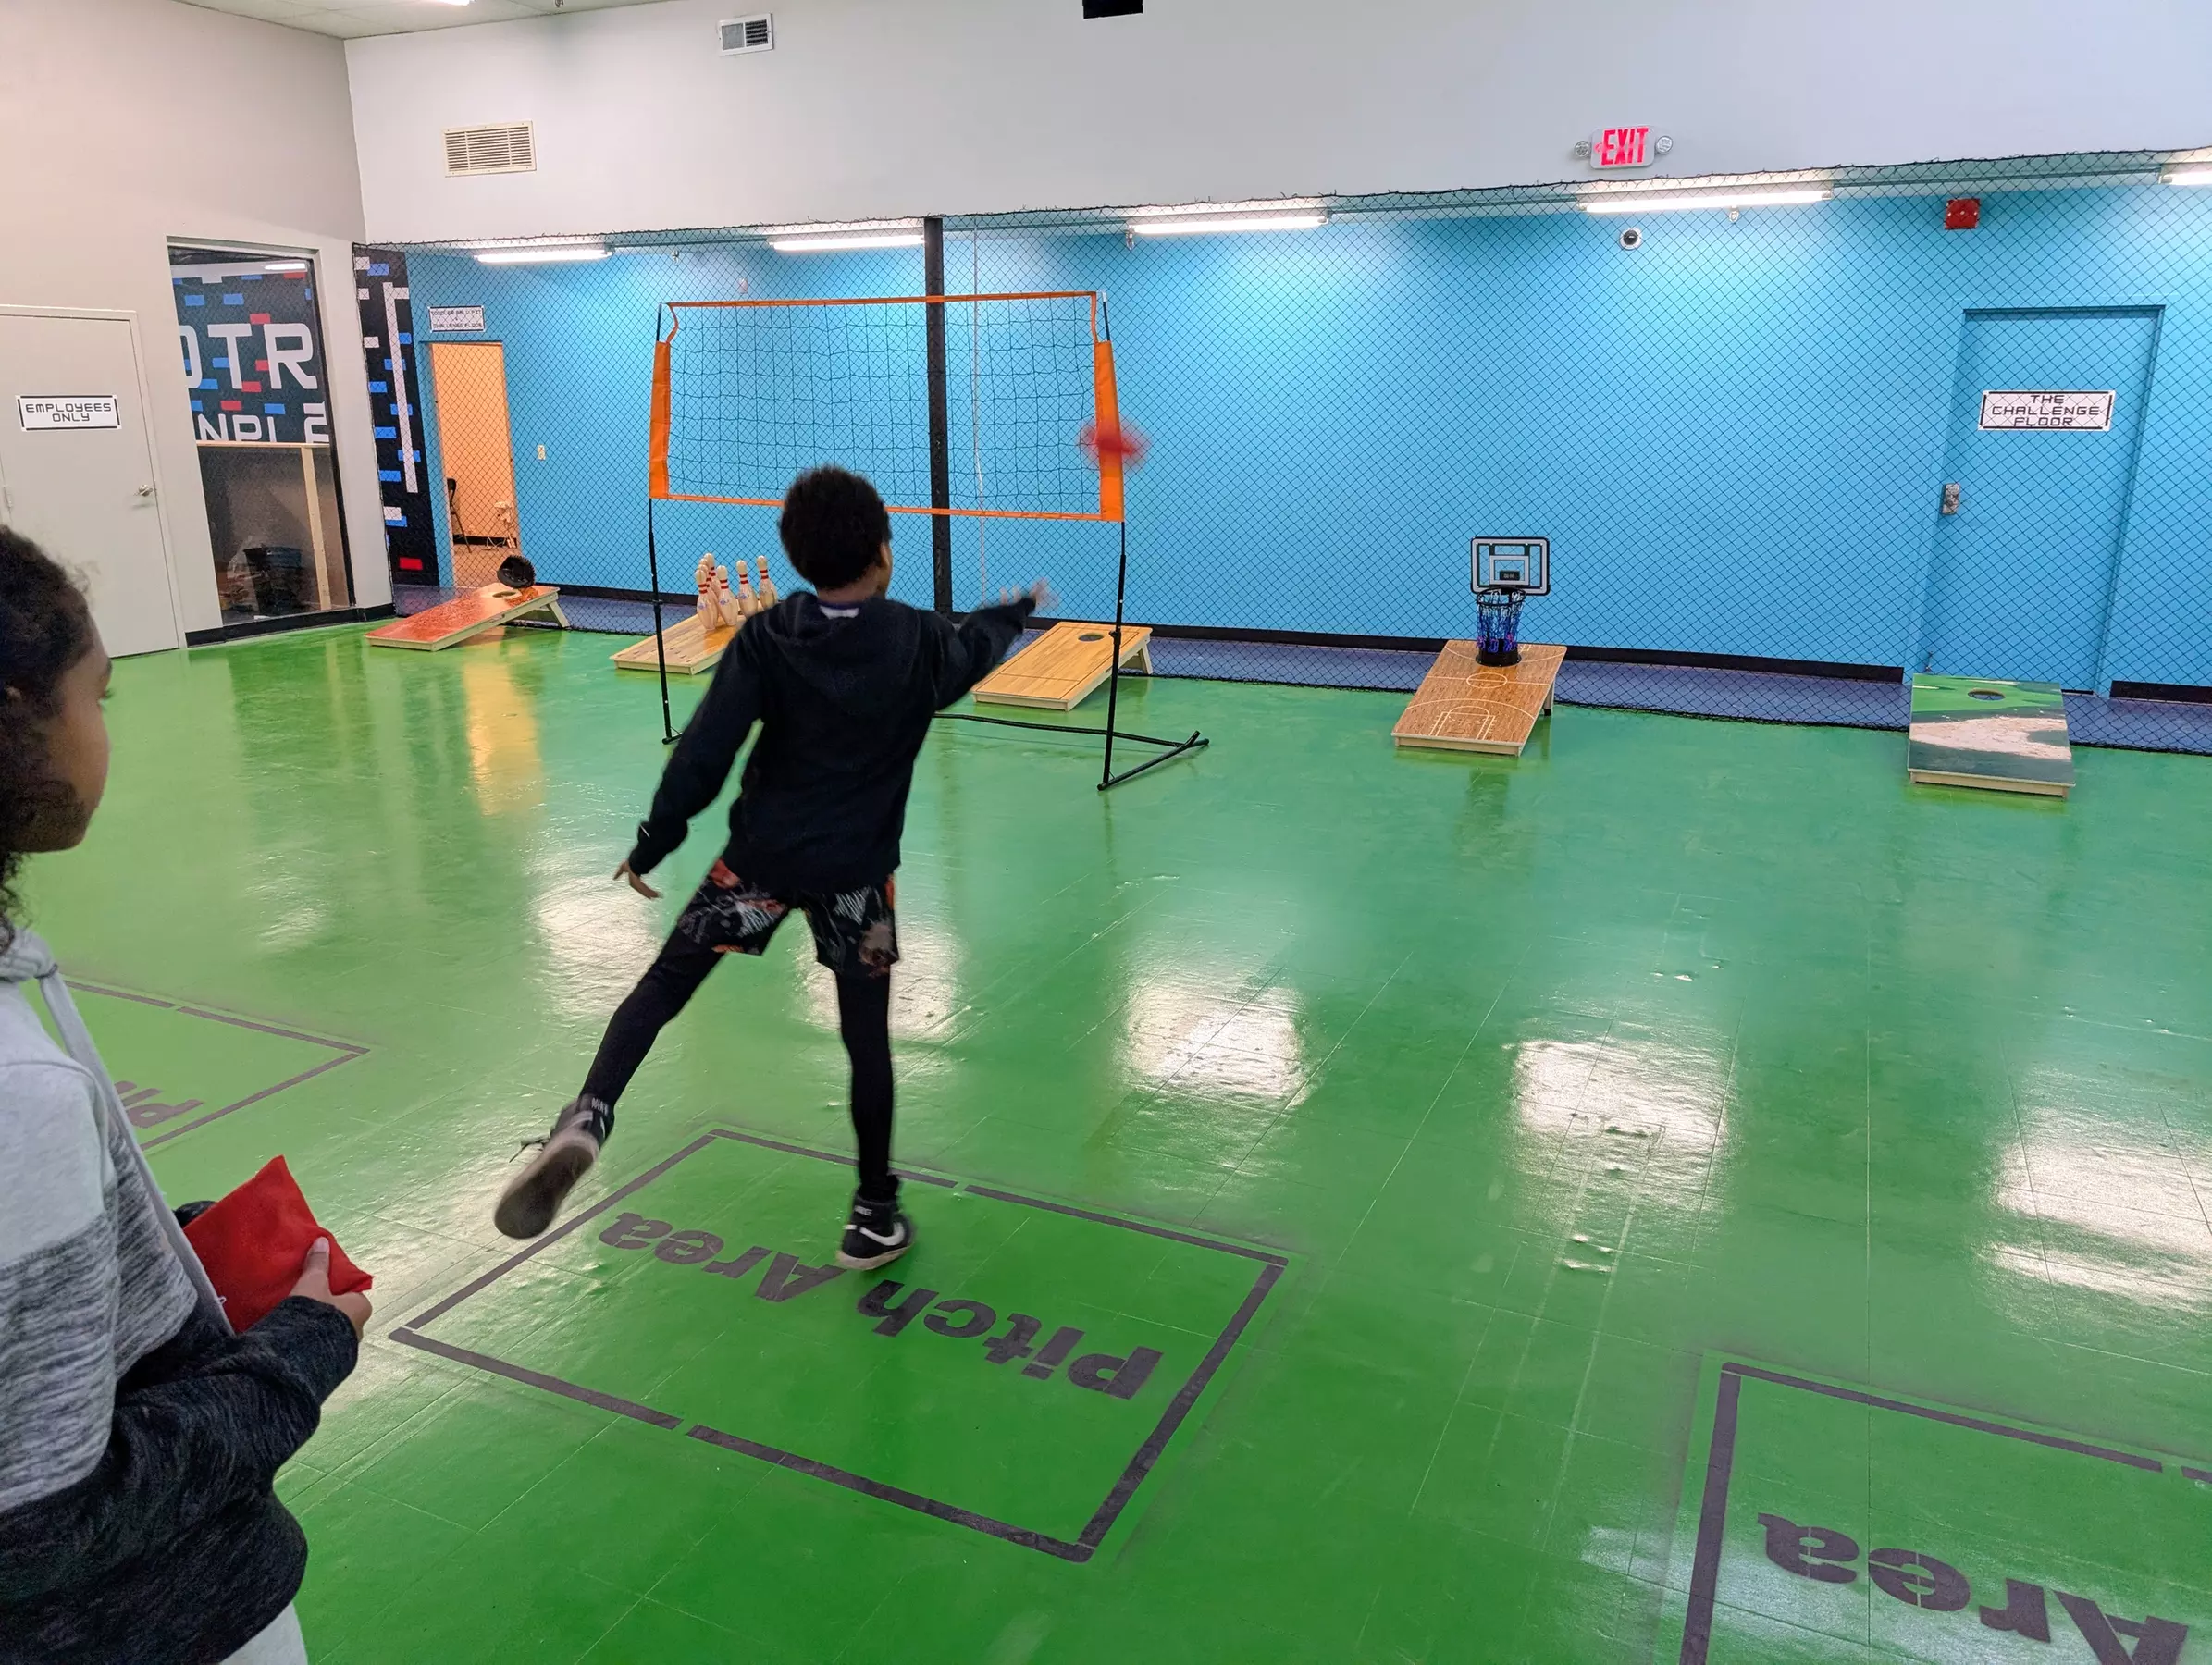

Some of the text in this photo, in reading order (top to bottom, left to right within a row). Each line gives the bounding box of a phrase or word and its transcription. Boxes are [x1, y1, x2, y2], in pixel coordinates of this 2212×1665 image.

[1601, 127, 1649, 166] EXIT
[2030, 395, 2065, 403] THE
[25, 403, 112, 413] EMPLOYEES
[1991, 406, 2100, 415] CHALLENGE
[52, 413, 90, 422] ONLY
[2014, 417, 2073, 426] FLOOR
[599, 1212, 1164, 1400] Pitch Area
[1757, 1512, 2190, 1665] Area
